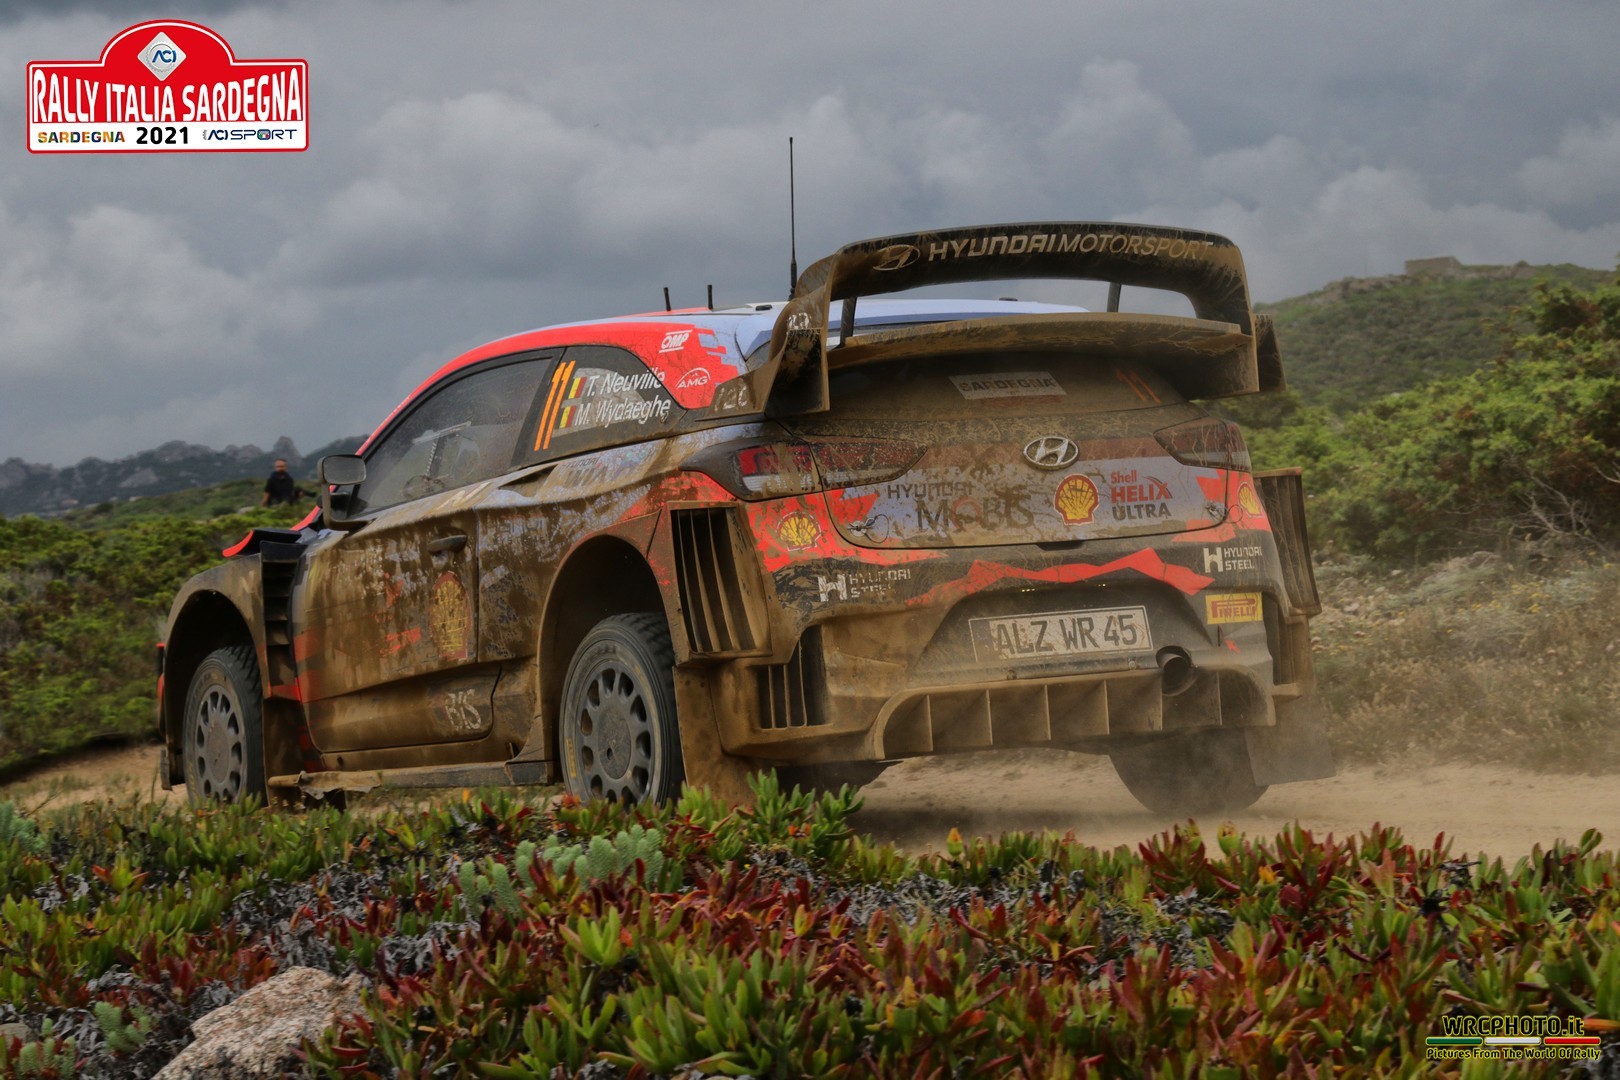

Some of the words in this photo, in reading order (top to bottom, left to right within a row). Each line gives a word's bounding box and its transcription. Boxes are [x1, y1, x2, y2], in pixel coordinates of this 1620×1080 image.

[928, 233, 1056, 262] HYUNDAI
[1057, 232, 1214, 260] MOTORSPORT
[661, 333, 690, 349] OMP
[587, 374, 601, 397] T.
[600, 366, 666, 395] Neuville
[677, 376, 708, 390] AMG
[959, 375, 1057, 393] SARDEGNA
[533, 360, 576, 452] 11
[574, 402, 592, 426] M.
[595, 394, 672, 428] Wydaeghe
[1111, 469, 1137, 484] Shell
[1111, 482, 1171, 504] HELIX
[1112, 502, 1172, 521] ULTRA
[1223, 546, 1263, 558] HYUNDAI
[1211, 598, 1257, 619] PIRELLI
[996, 620, 1053, 655] ALZ
[1060, 617, 1100, 650] WR
[1104, 614, 1138, 646] 45
